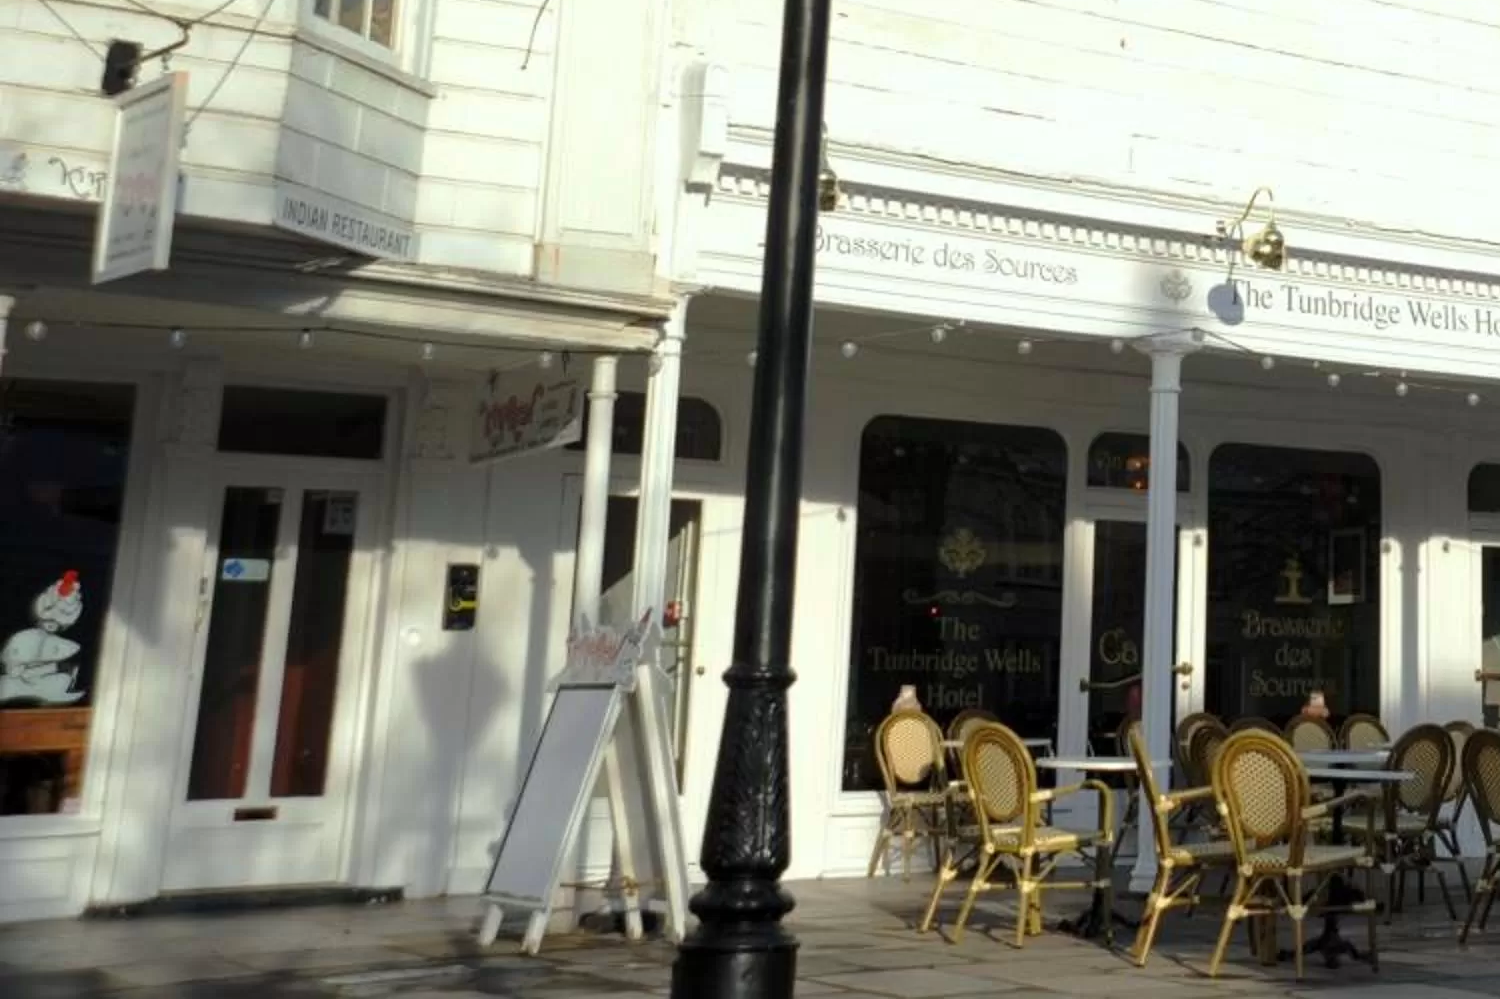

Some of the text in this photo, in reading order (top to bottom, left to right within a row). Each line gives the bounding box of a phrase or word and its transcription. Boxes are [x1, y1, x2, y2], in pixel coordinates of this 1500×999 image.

[283, 197, 411, 257] INDIAN RESTAURANT
[816, 224, 1079, 284] Brasserie des Sources
[1234, 279, 1273, 309] The
[1280, 284, 1400, 329] Tunbridge
[1407, 301, 1469, 331] Wells
[933, 616, 981, 641] The
[1241, 609, 1344, 639] Brasserie
[867, 645, 1041, 679] Tunbridge Wells
[1275, 641, 1313, 668] des
[927, 683, 983, 707] Hotel
